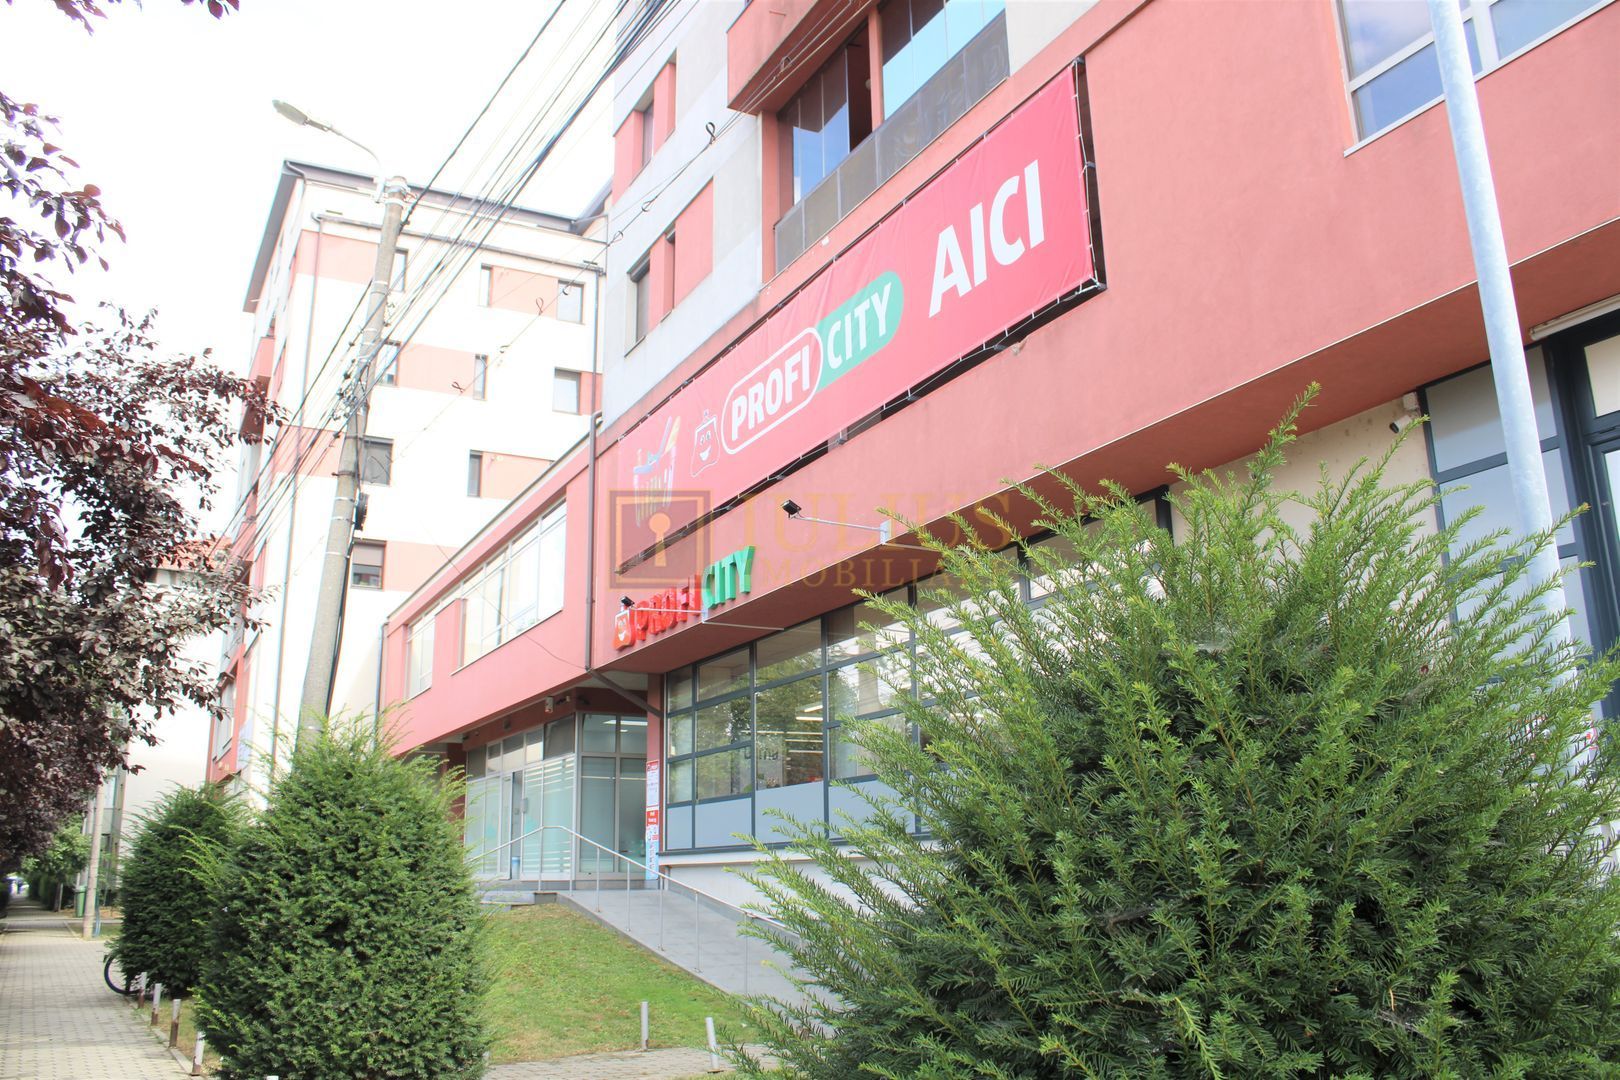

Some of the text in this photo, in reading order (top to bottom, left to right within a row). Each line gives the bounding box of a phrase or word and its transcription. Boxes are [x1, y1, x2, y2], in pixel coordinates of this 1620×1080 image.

[731, 159, 1046, 441] PROFI CITY AICI
[702, 546, 756, 610] CITY
